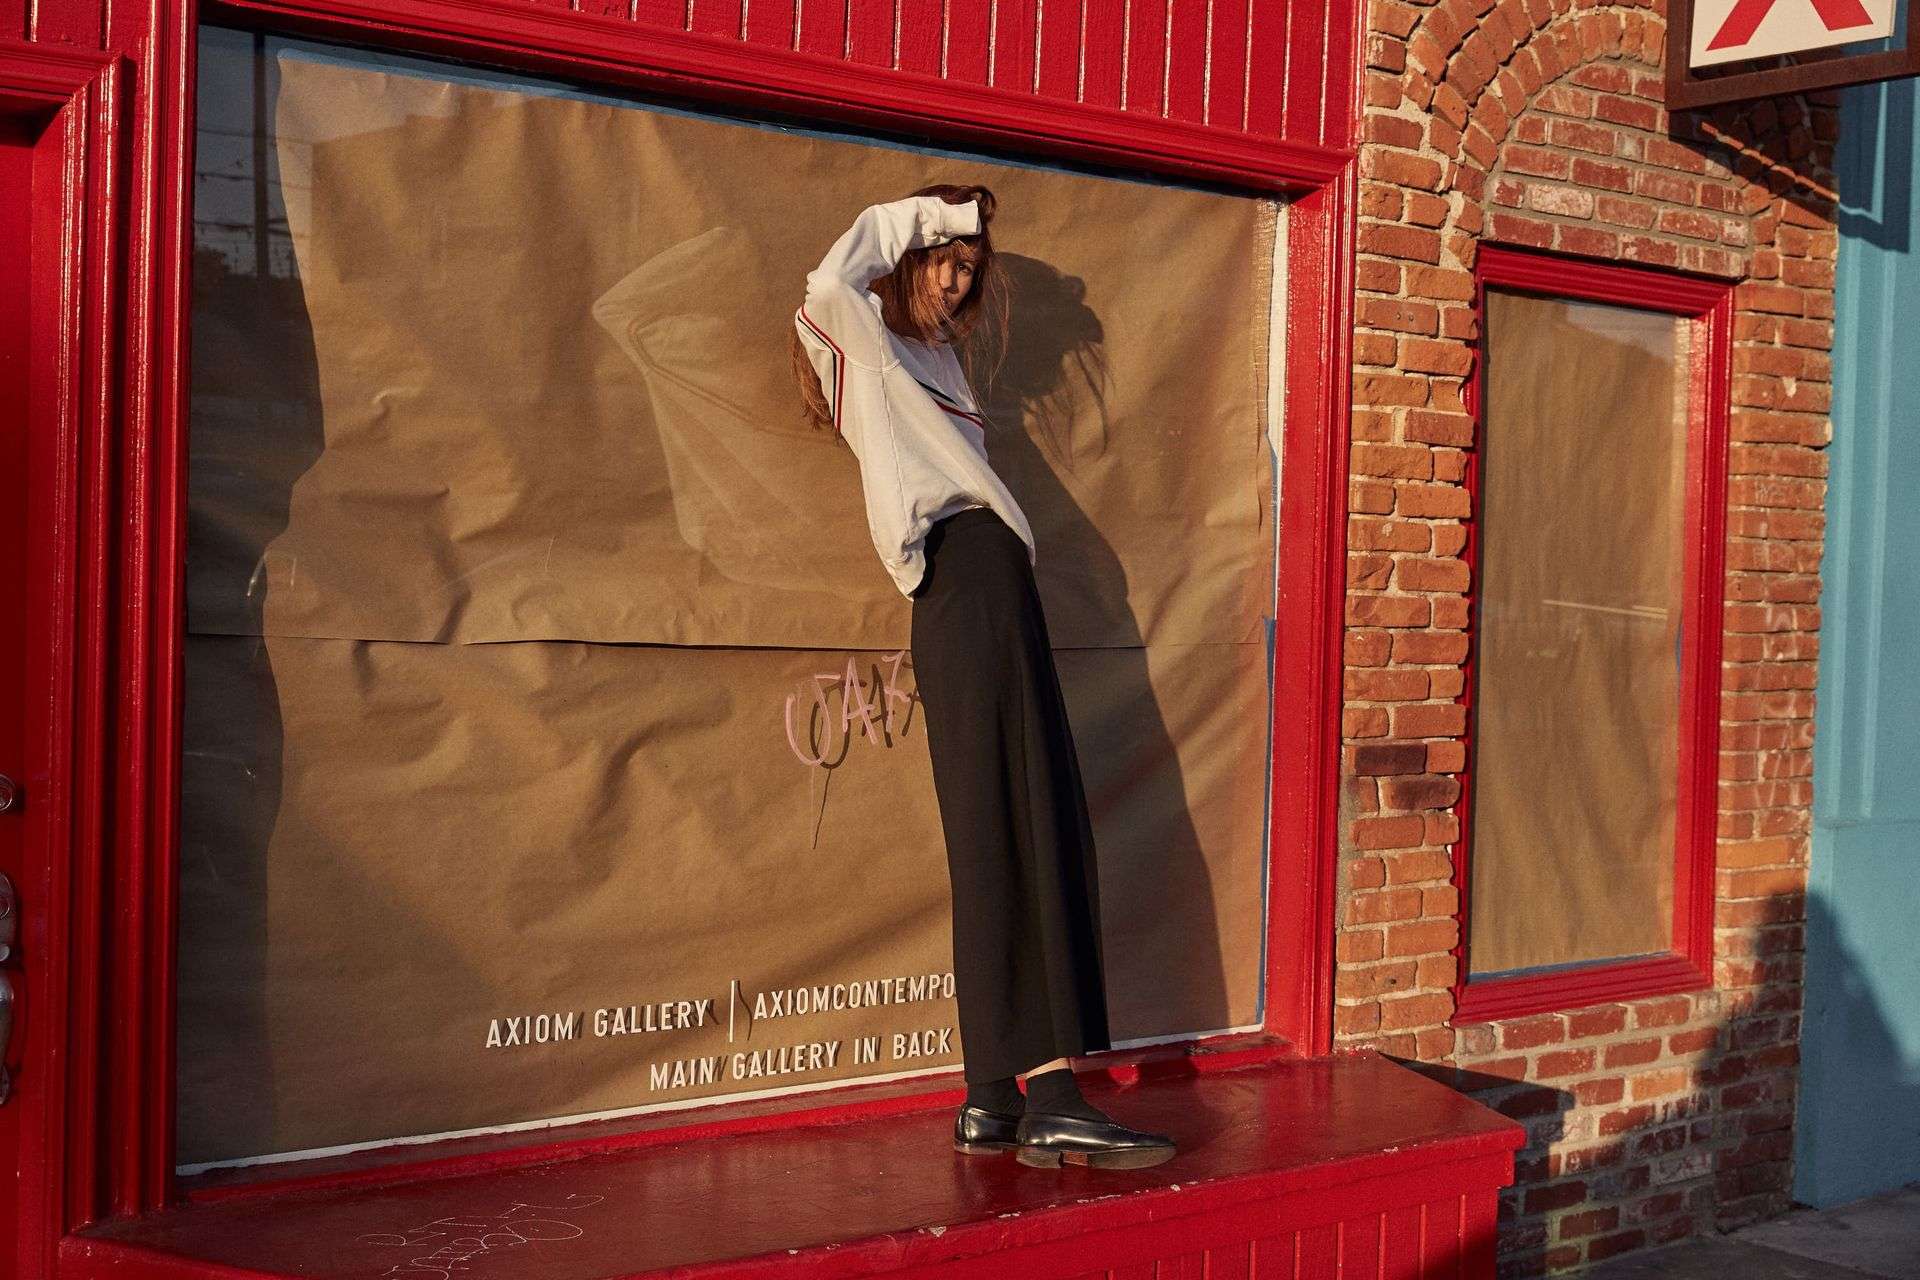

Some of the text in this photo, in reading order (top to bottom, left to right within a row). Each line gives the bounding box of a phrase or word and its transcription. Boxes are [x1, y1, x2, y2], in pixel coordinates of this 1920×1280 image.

[485, 972, 955, 1049] AXIOM GALLERY AXIOMCONTEMPO
[649, 1027, 953, 1091] MAIN GALLERY IN BACK
